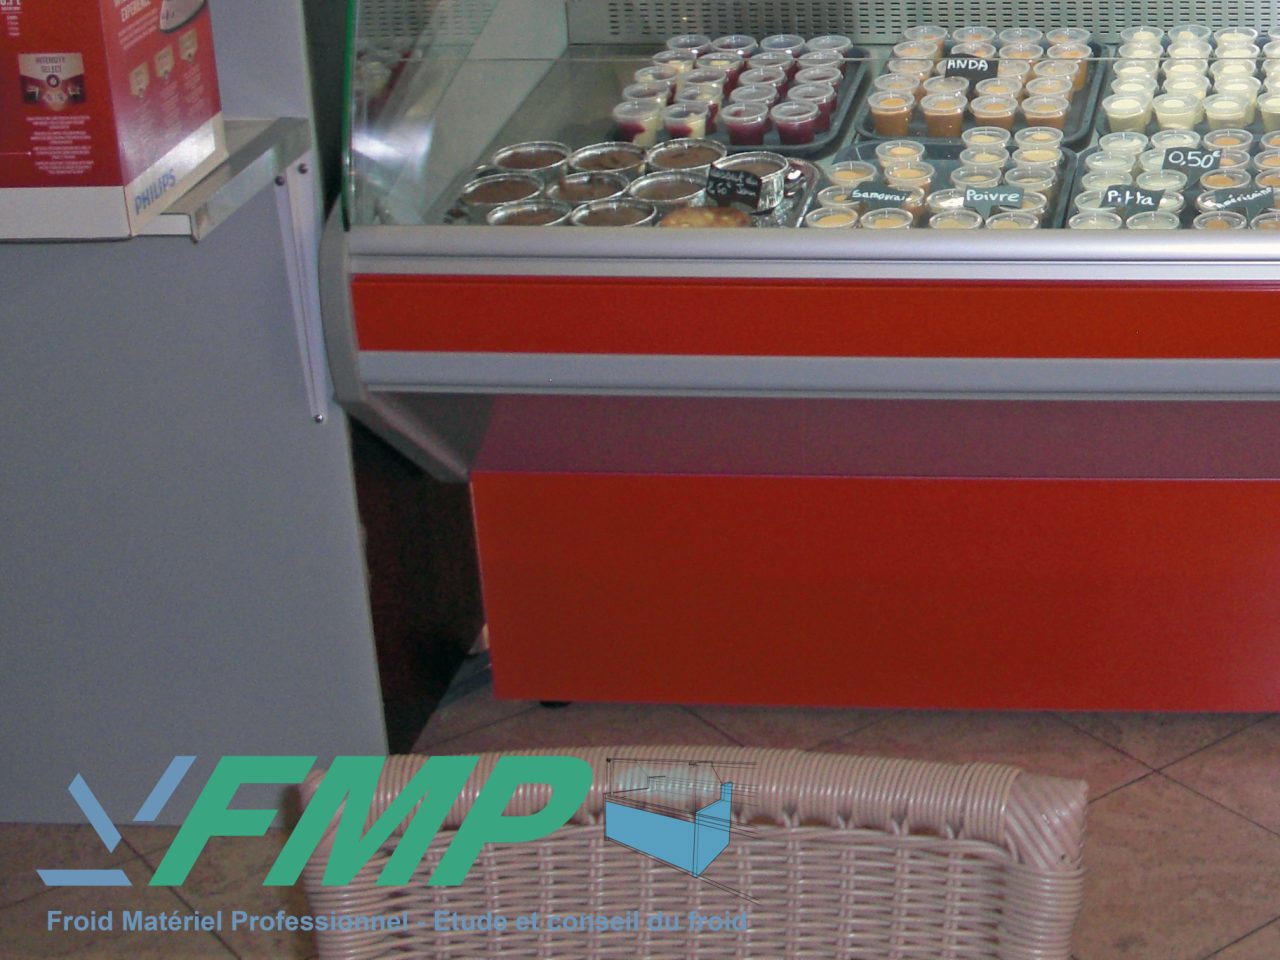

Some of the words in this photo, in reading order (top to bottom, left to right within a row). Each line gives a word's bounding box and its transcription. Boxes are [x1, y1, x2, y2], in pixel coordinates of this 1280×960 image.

[947, 58, 989, 71] ANDA
[1169, 150, 1221, 168] 0,50€
[134, 168, 177, 215] PHILIPS
[966, 189, 1021, 202] Poivre
[1107, 190, 1155, 206] Pitta
